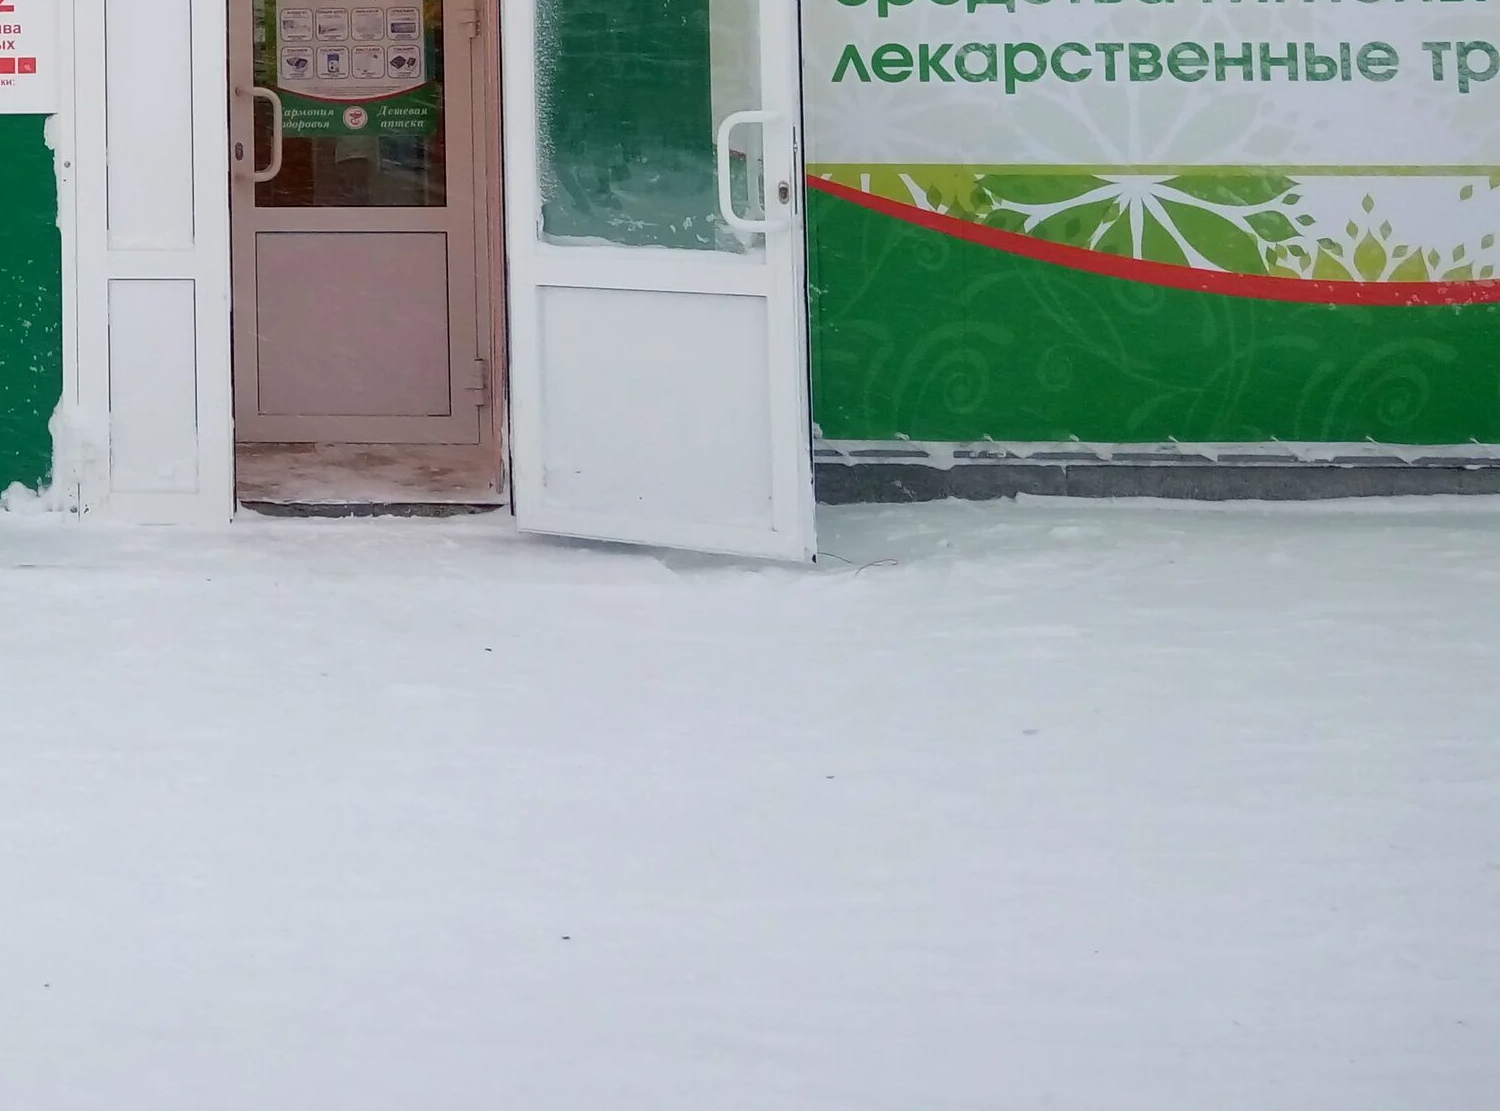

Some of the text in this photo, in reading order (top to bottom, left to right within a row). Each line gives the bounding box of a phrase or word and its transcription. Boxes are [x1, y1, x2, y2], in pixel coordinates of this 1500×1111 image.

[831, 40, 1500, 95] лекарственные тр
[282, 107, 334, 120] армония
[377, 105, 428, 117] Дешевая
[380, 119, 425, 129] аптека
